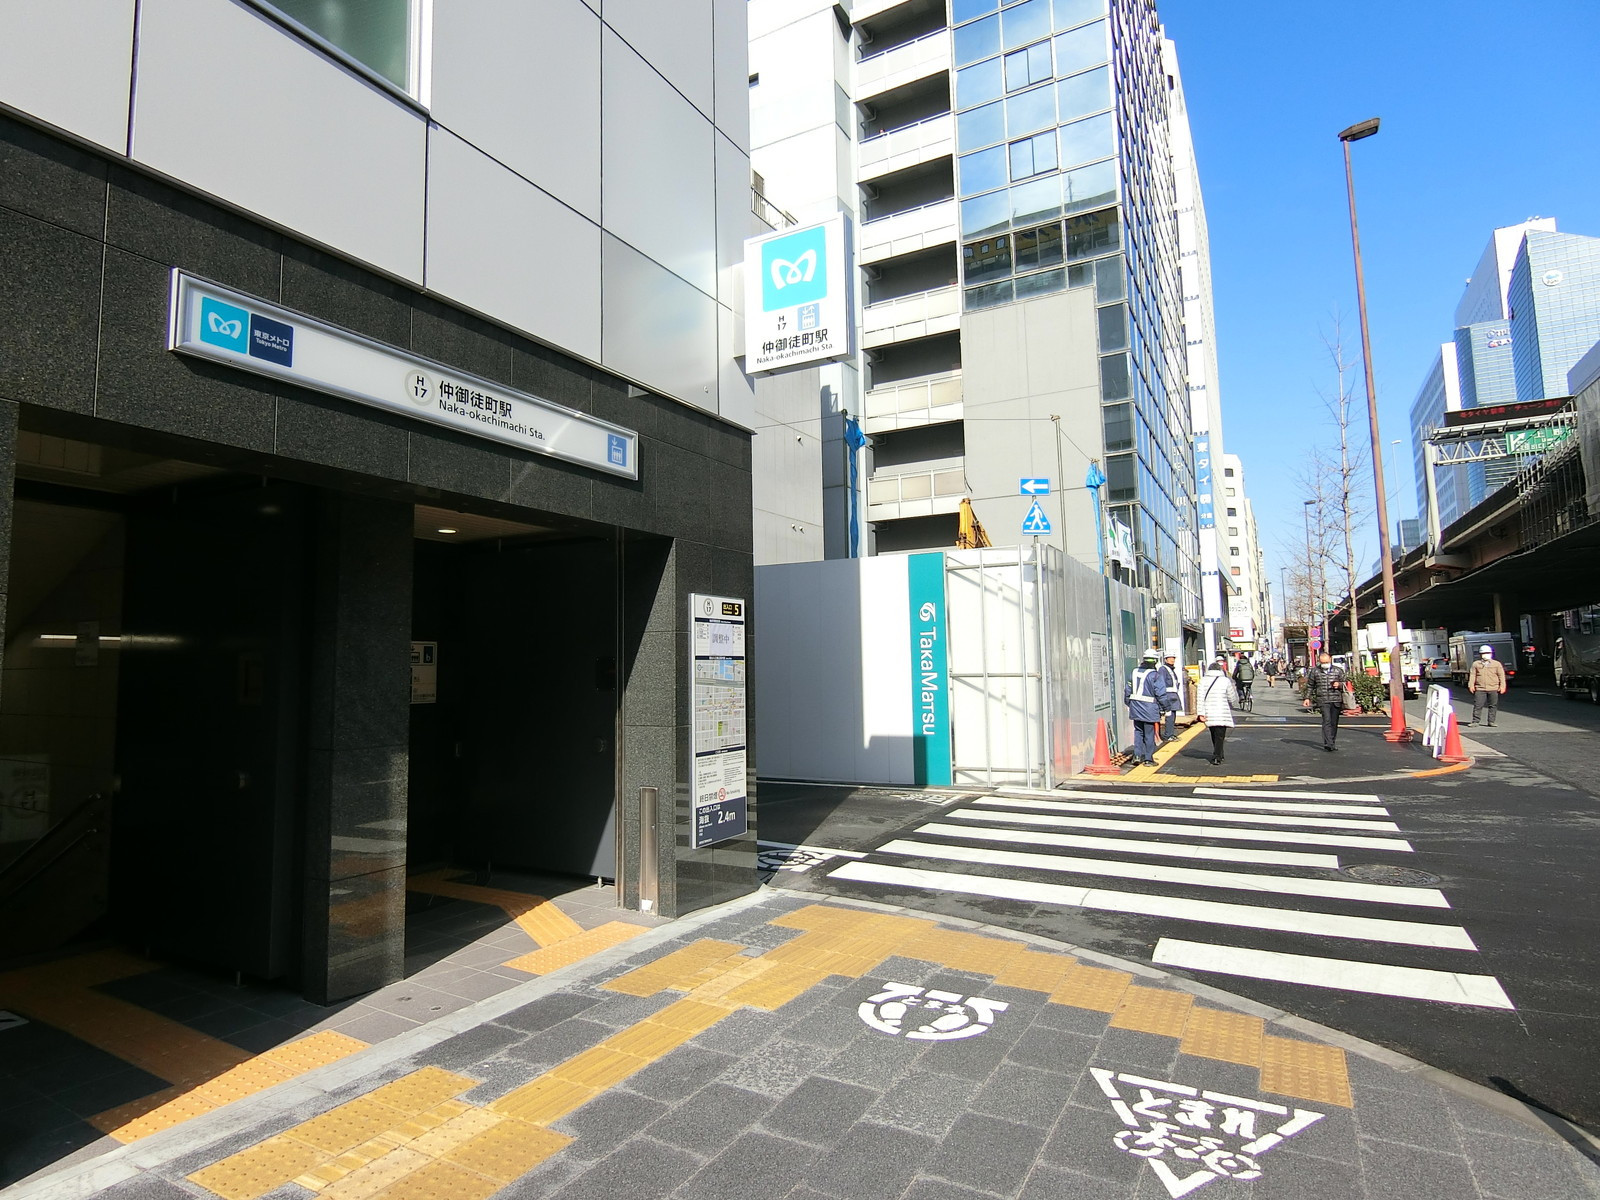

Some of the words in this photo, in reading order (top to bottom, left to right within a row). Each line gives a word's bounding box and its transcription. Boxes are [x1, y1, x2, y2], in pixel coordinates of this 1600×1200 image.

[777, 322, 787, 330] 17
[254, 329, 290, 347] 東京メトロ
[256, 337, 271, 347] Tokyo
[271, 342, 287, 352] Metro
[762, 328, 828, 355] 仲御徒町駅
[756, 345, 820, 364] Naka-okachimachi
[416, 375, 424, 386] H
[414, 386, 427, 398] 17
[439, 381, 512, 419] 仲御徒町駅
[439, 399, 527, 435] Naka-okachimachi
[529, 427, 546, 440] Sta.
[734, 604, 739, 615] 5
[717, 810, 736, 824] 2.4m
[1132, 1088, 1256, 1140] とまれ
